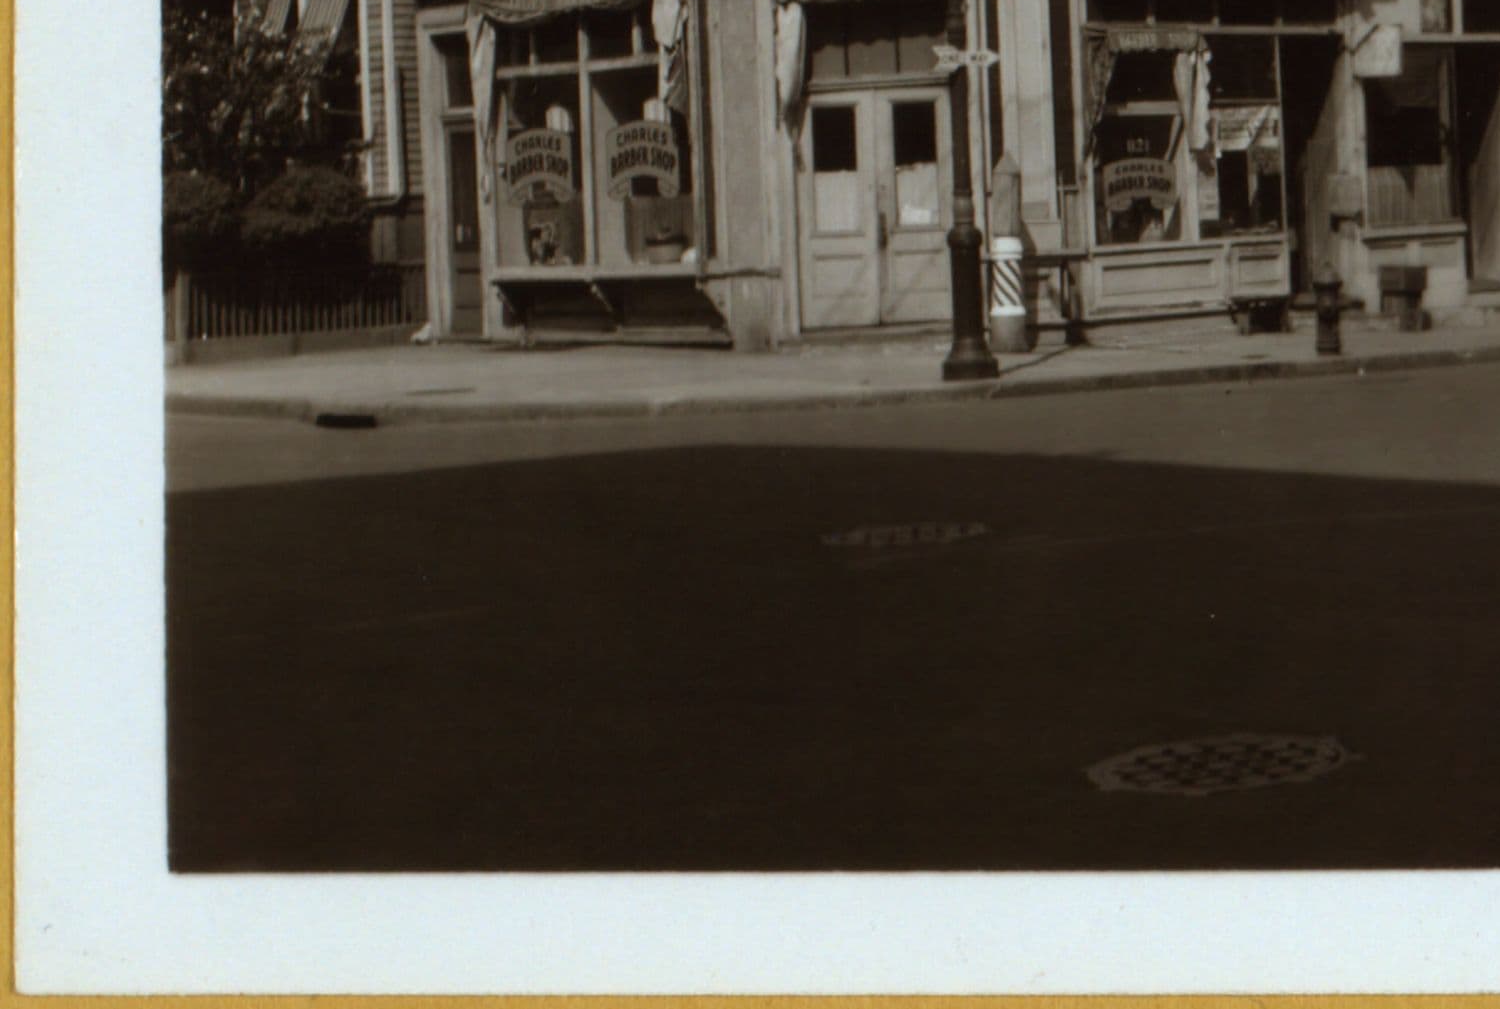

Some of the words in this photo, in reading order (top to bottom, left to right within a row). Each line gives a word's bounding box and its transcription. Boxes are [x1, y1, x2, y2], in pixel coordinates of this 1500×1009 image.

[514, 135, 561, 155] CHARLES
[615, 127, 666, 148] CHARLES
[509, 152, 544, 185] BARBER
[545, 152, 569, 179] SHOP
[610, 145, 648, 179] BARBER
[649, 145, 676, 175] SHOP
[1114, 164, 1164, 175] CHARLES
[1108, 175, 1145, 197] BARBER
[1147, 175, 1171, 194] SHOP
